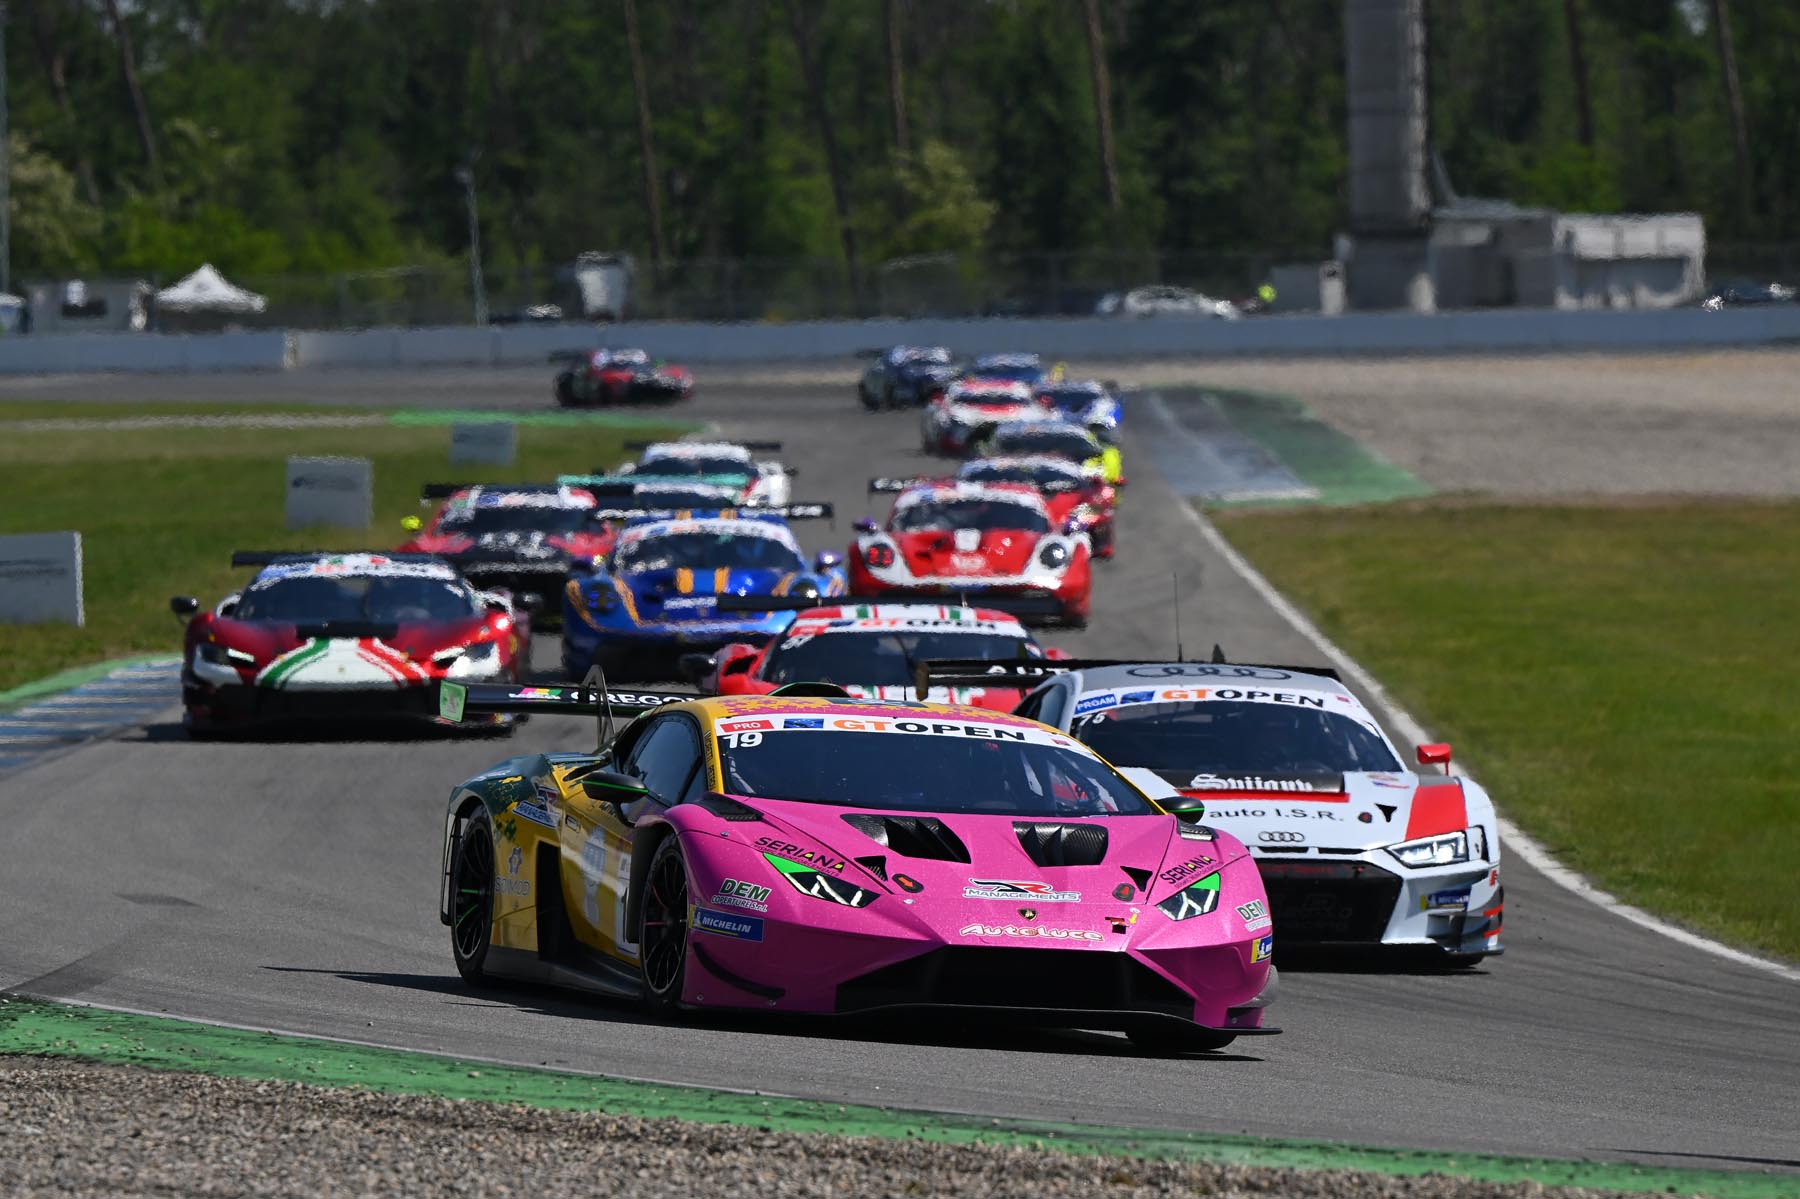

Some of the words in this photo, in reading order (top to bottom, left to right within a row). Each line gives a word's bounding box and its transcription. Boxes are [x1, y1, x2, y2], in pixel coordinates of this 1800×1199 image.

[1076, 696, 1116, 711] PROAM
[732, 722, 761, 730] PRO
[723, 732, 763, 749] 19
[1209, 808, 1265, 819] auto
[754, 836, 847, 873] SERIANA
[1160, 855, 1216, 885] SERIANA
[719, 878, 772, 903] DEM
[967, 888, 1078, 900] MANAGEMENTS
[702, 916, 752, 934] MICHELIN
